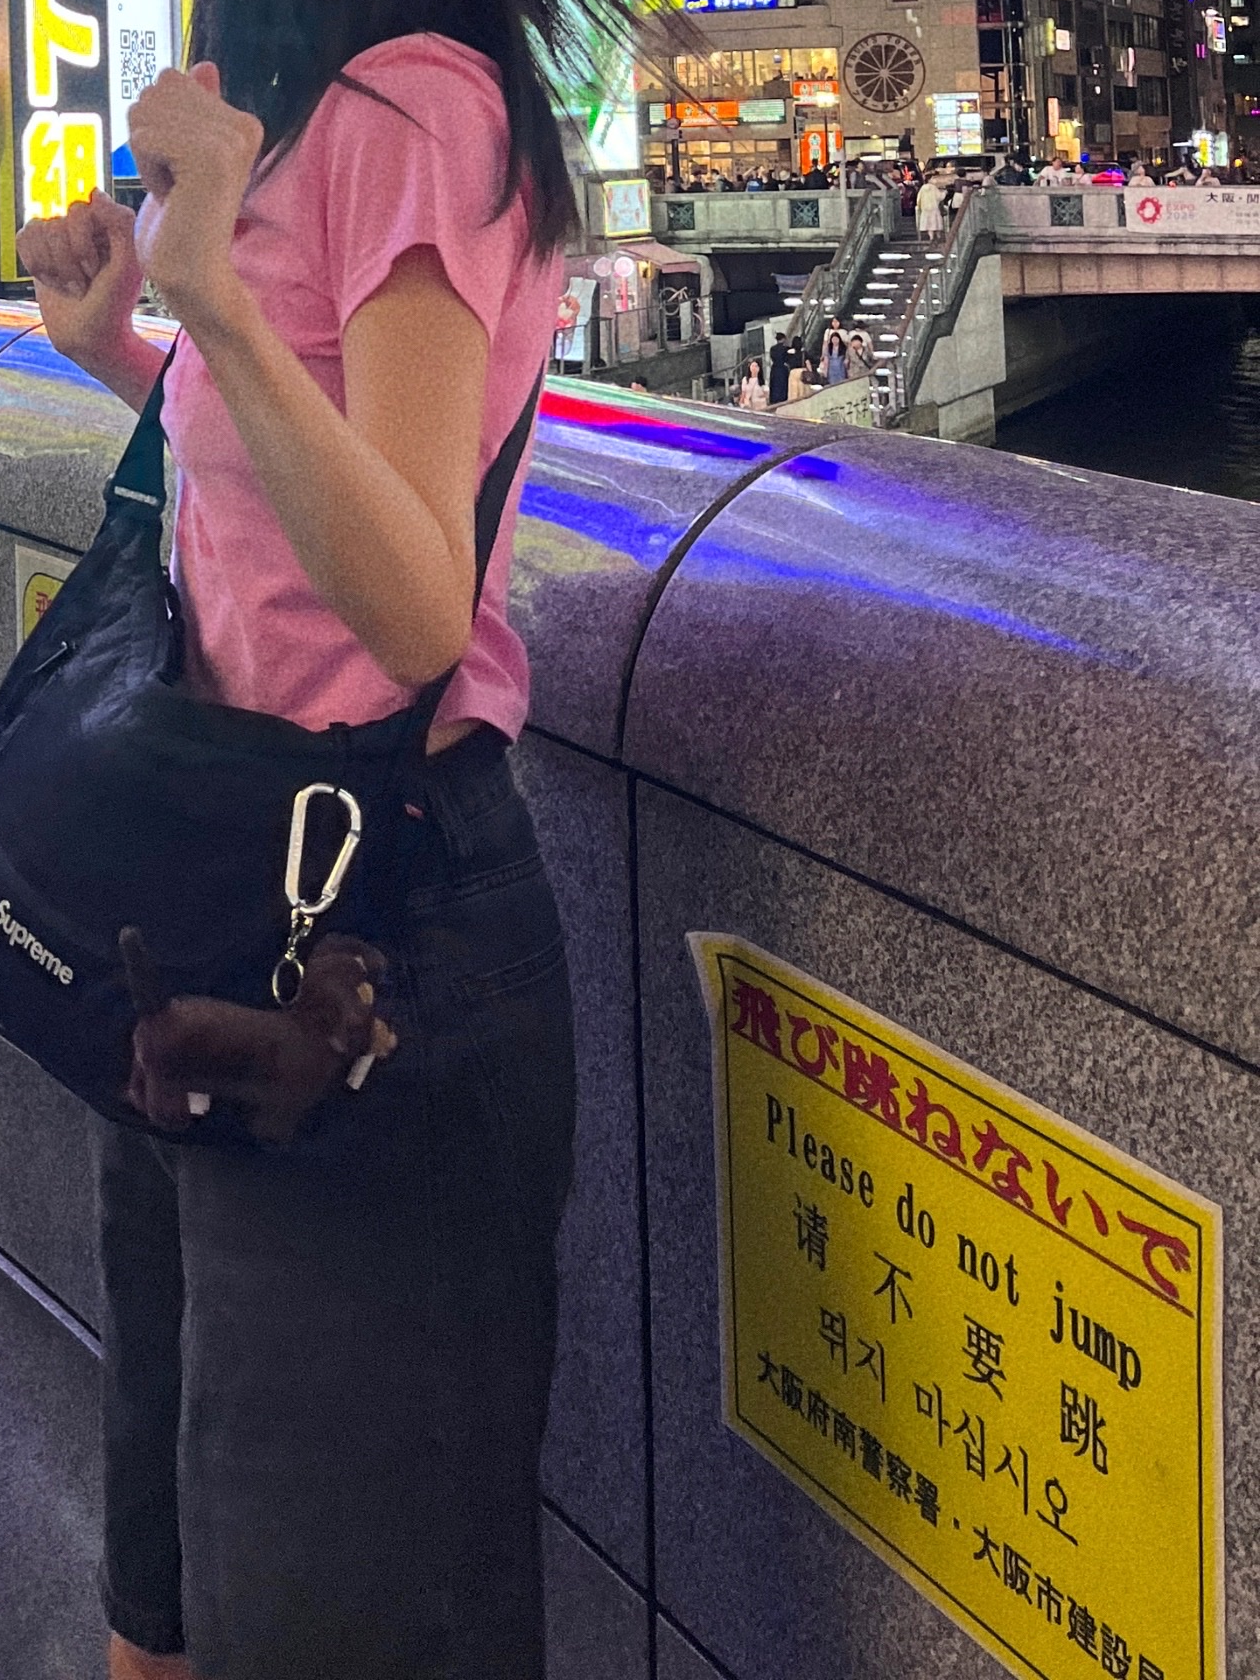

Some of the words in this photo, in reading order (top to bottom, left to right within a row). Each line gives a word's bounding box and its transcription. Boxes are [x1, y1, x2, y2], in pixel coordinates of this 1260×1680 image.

[1166, 202, 1196, 211] EXPO
[730, 975, 1194, 1300] 飛び跳ねないで
[766, 1093, 875, 1209] Please
[896, 1183, 936, 1249] do
[957, 1233, 1019, 1307] not
[1050, 1280, 1142, 1392] jump
[912, 1381, 1079, 1547] 마십시오
